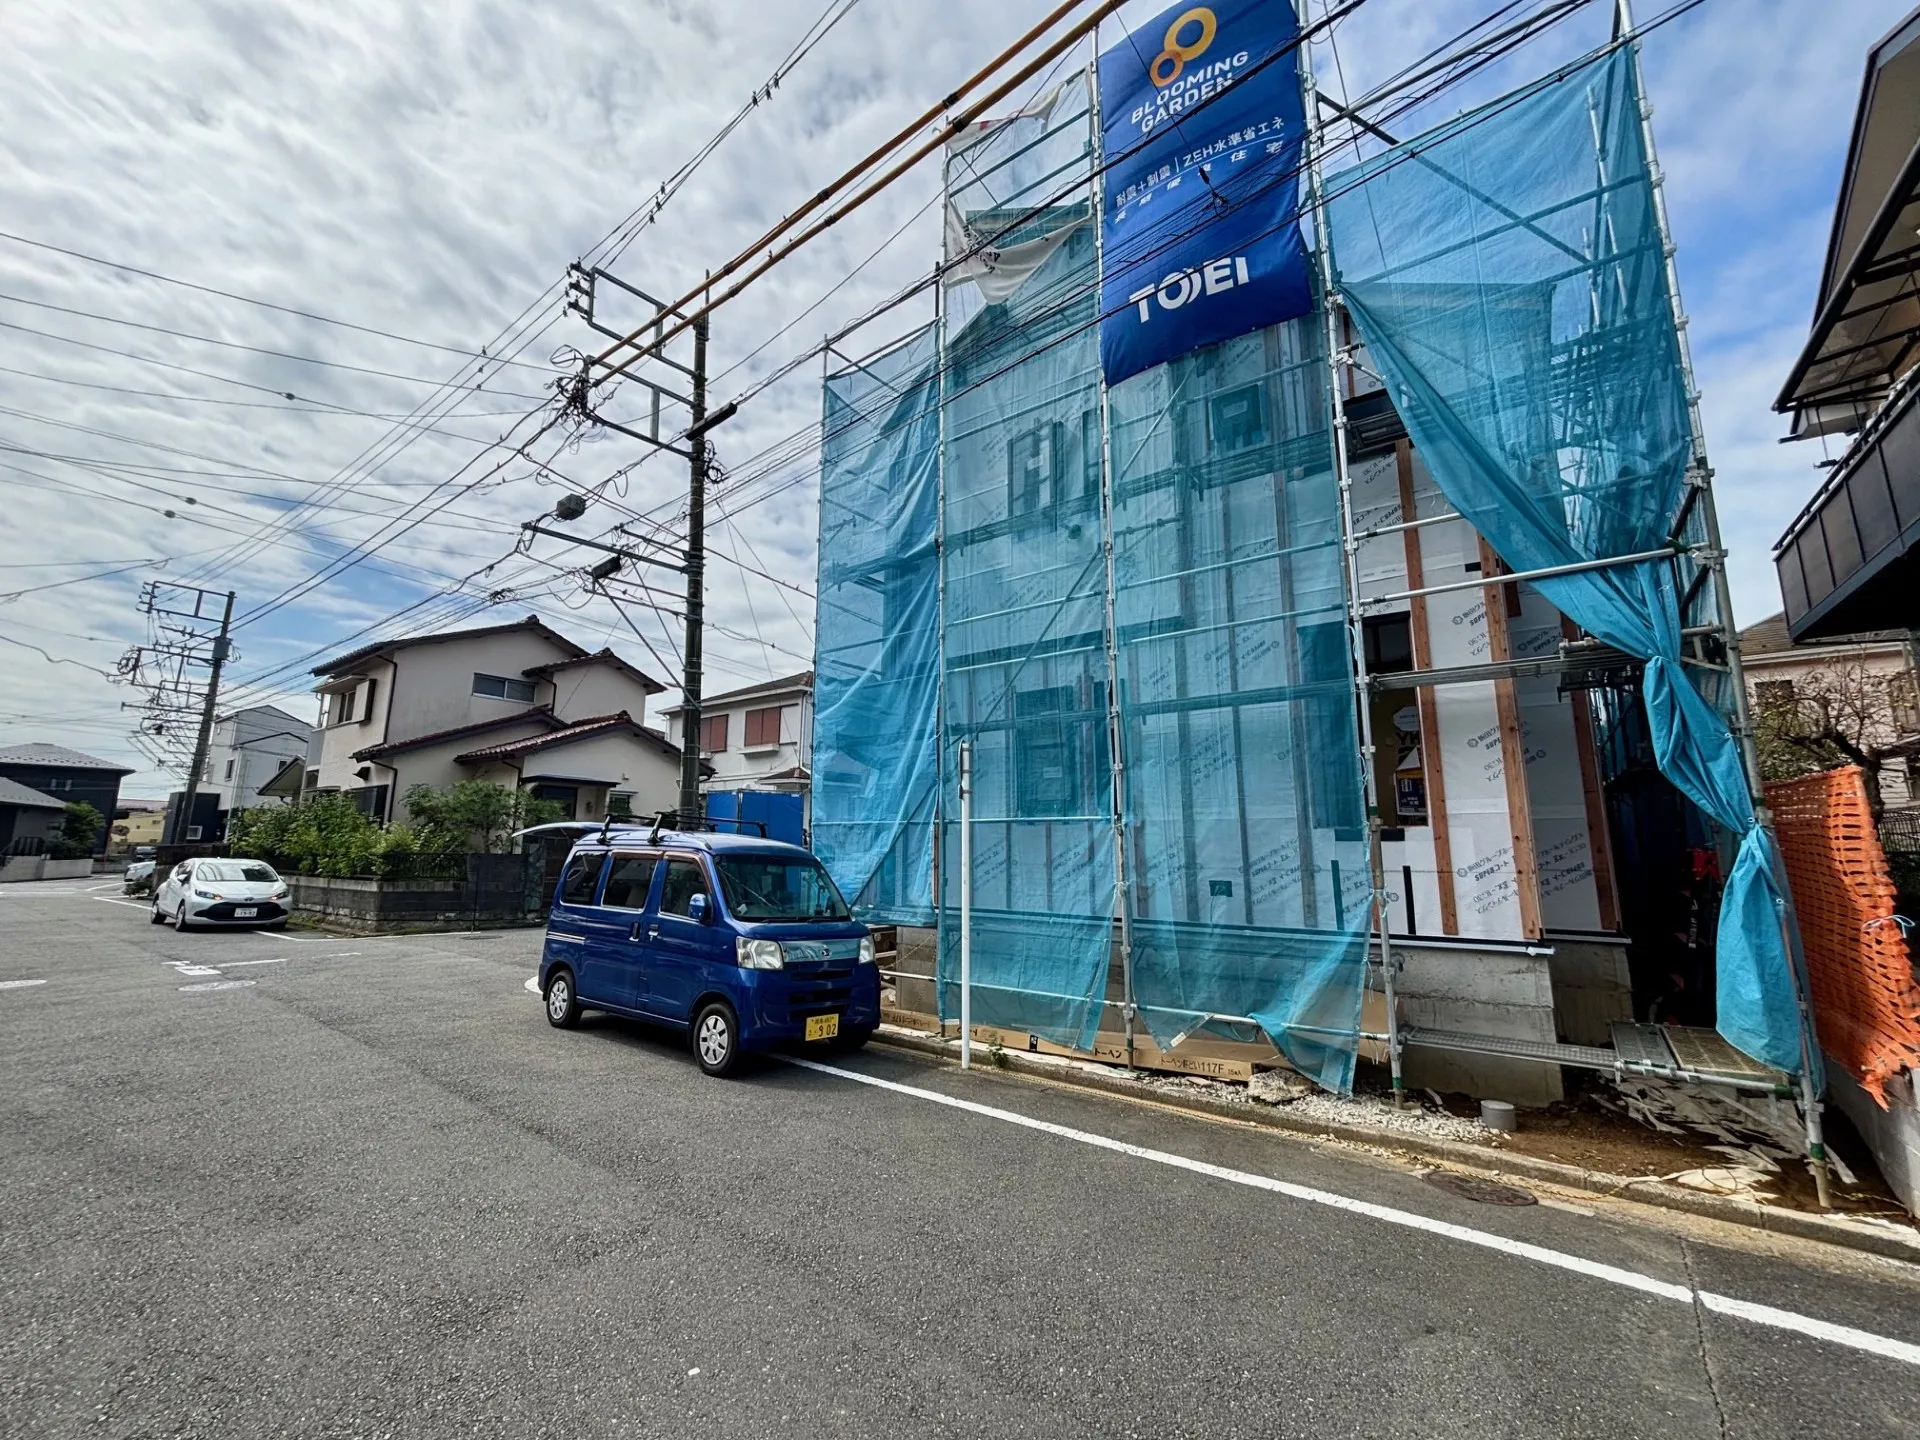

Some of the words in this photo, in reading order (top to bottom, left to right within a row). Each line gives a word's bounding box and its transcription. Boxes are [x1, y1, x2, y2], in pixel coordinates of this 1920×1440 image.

[1131, 51, 1249, 125] BLOOMING
[1141, 72, 1235, 133] GARDEN
[1129, 256, 1250, 323] TOEI
